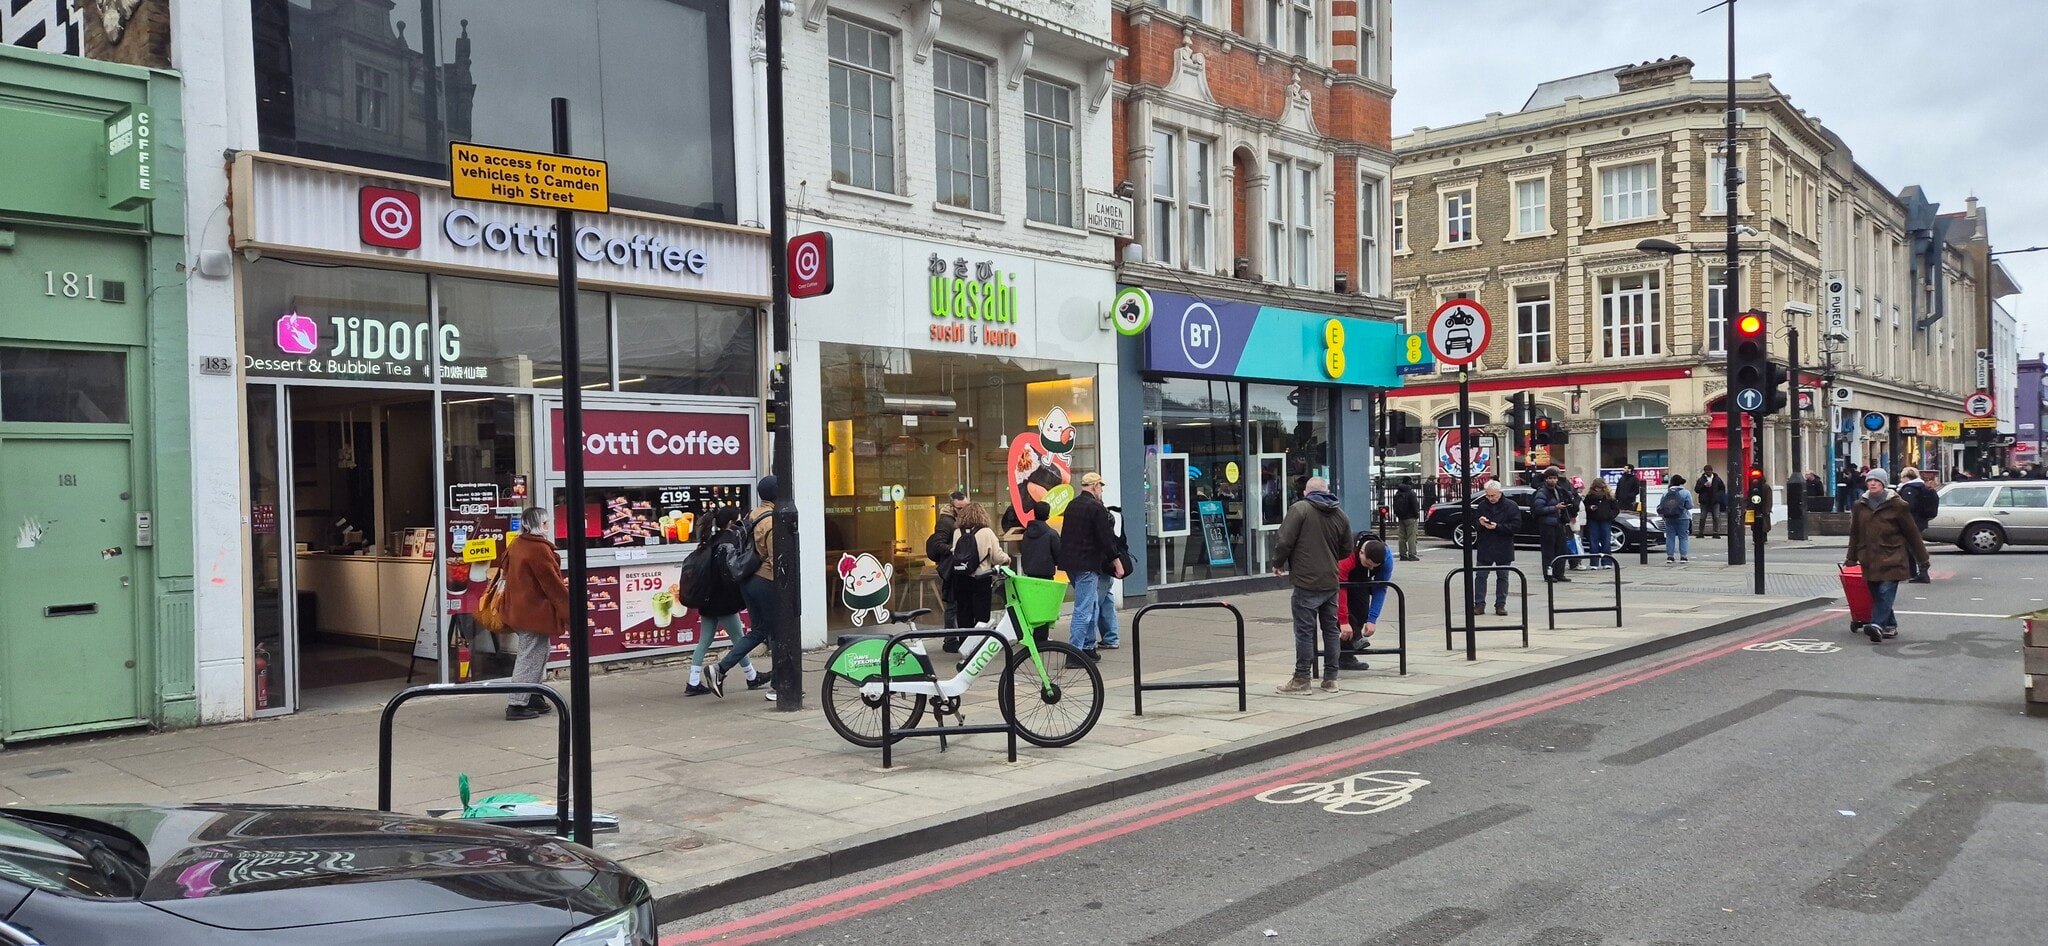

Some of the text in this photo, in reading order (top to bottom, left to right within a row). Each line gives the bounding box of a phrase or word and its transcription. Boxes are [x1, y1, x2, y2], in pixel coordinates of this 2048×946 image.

[138, 112, 150, 190] COFFEE
[458, 149, 601, 178] No access for motor
[461, 166, 599, 192] vehicles to Camden
[491, 183, 574, 203] High Street
[1088, 213, 1125, 231] HIGH STREET
[1096, 202, 1123, 219] CAMDEN
[575, 226, 708, 275] Coffee
[928, 251, 994, 282] わさび
[44, 270, 98, 300] 181
[929, 269, 1017, 324] wasabi
[1831, 296, 1842, 327] PUREG
[929, 321, 966, 343] sushi
[982, 323, 1018, 347] bento
[1190, 322, 1213, 348] BT
[204, 356, 229, 371] 183
[244, 355, 412, 376] Dessert & Bubble Tea
[646, 428, 740, 455] Coffee
[58, 474, 78, 487] 181
[660, 490, 691, 504] £1.99
[469, 547, 490, 555] OPEN
[964, 641, 1000, 676] Lime
